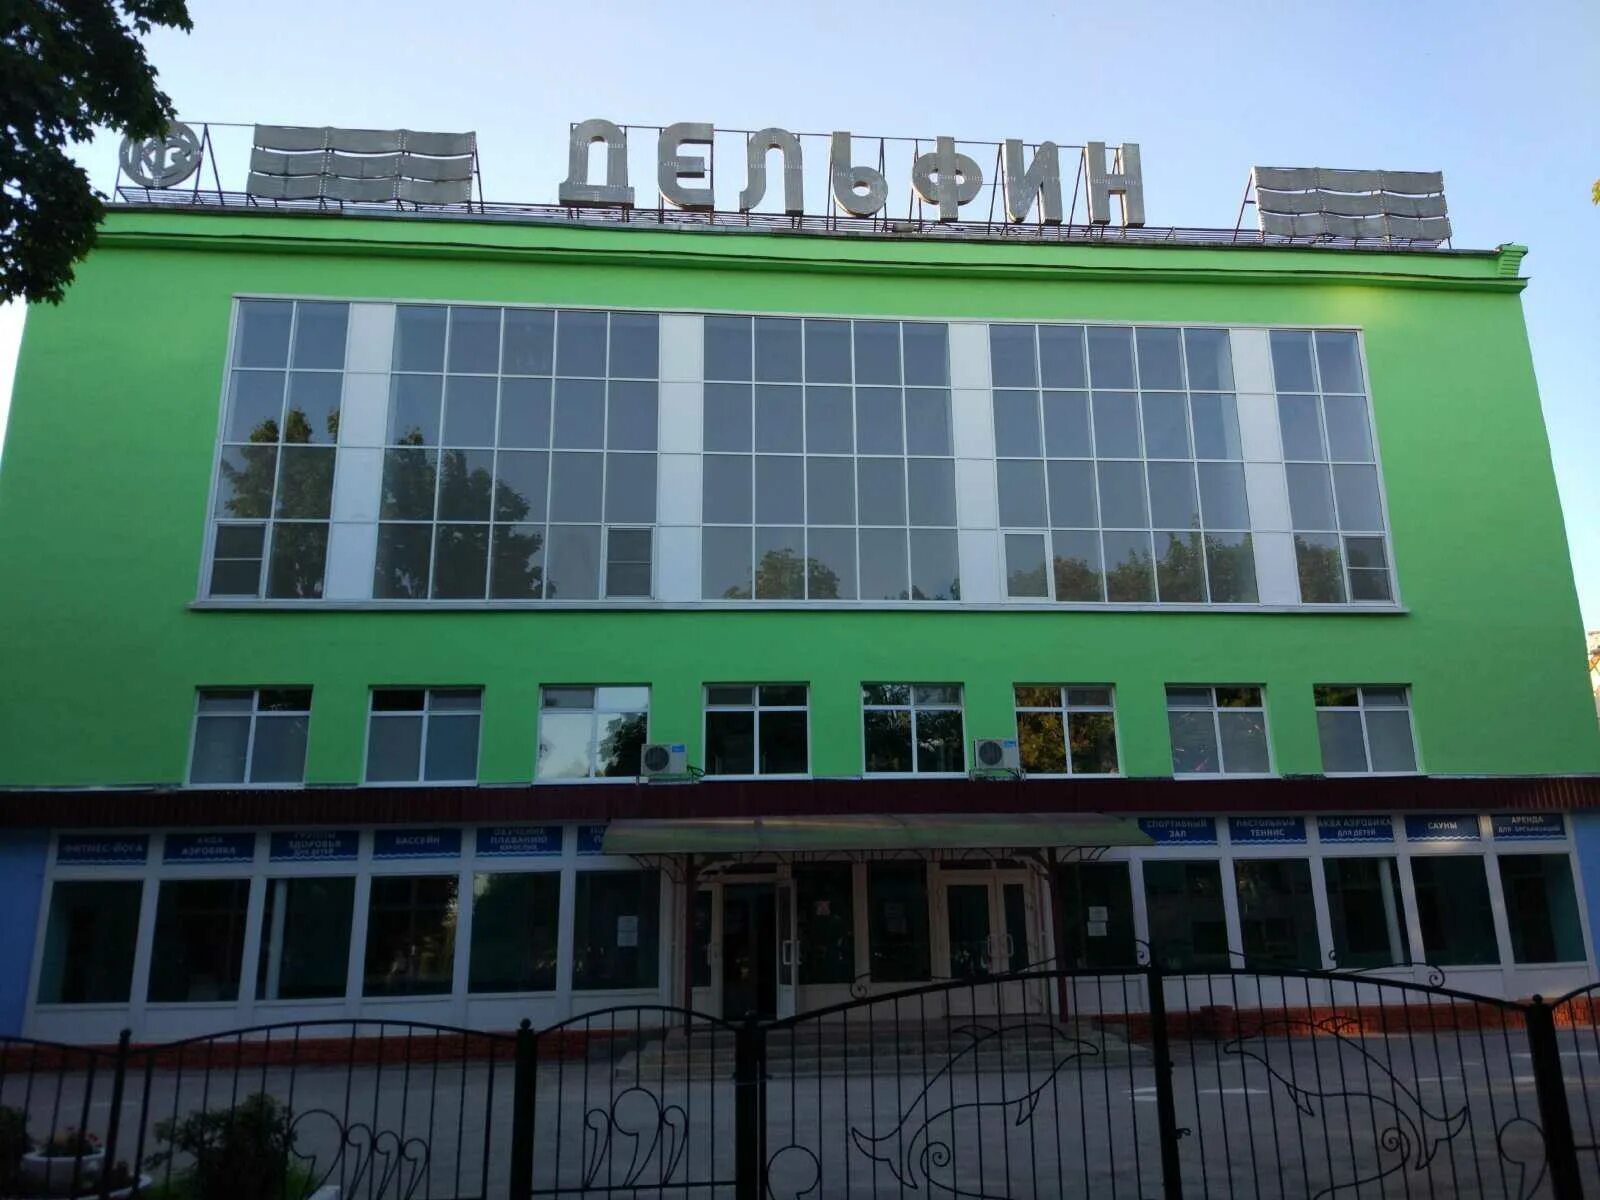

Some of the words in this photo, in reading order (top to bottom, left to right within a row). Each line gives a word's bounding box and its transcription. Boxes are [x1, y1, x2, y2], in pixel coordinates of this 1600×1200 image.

[559, 119, 1145, 228] ДЕЛЬФИН
[1147, 818, 1207, 828] СПОРТИВНЫЙ
[1343, 817, 1392, 827] АЭРОБИКА
[1511, 815, 1544, 824] АРЕНДА
[1428, 821, 1457, 829] САУНЫ
[1169, 830, 1187, 838] ЗАЛ
[1250, 829, 1285, 837] ТЕННИС
[288, 840, 342, 849] ЗДОРОВЬЯ
[396, 836, 440, 846] БАССЕЙН
[490, 836, 548, 844] ПЛАВАНИЮ
[181, 847, 235, 856] АЭРОБИКА
